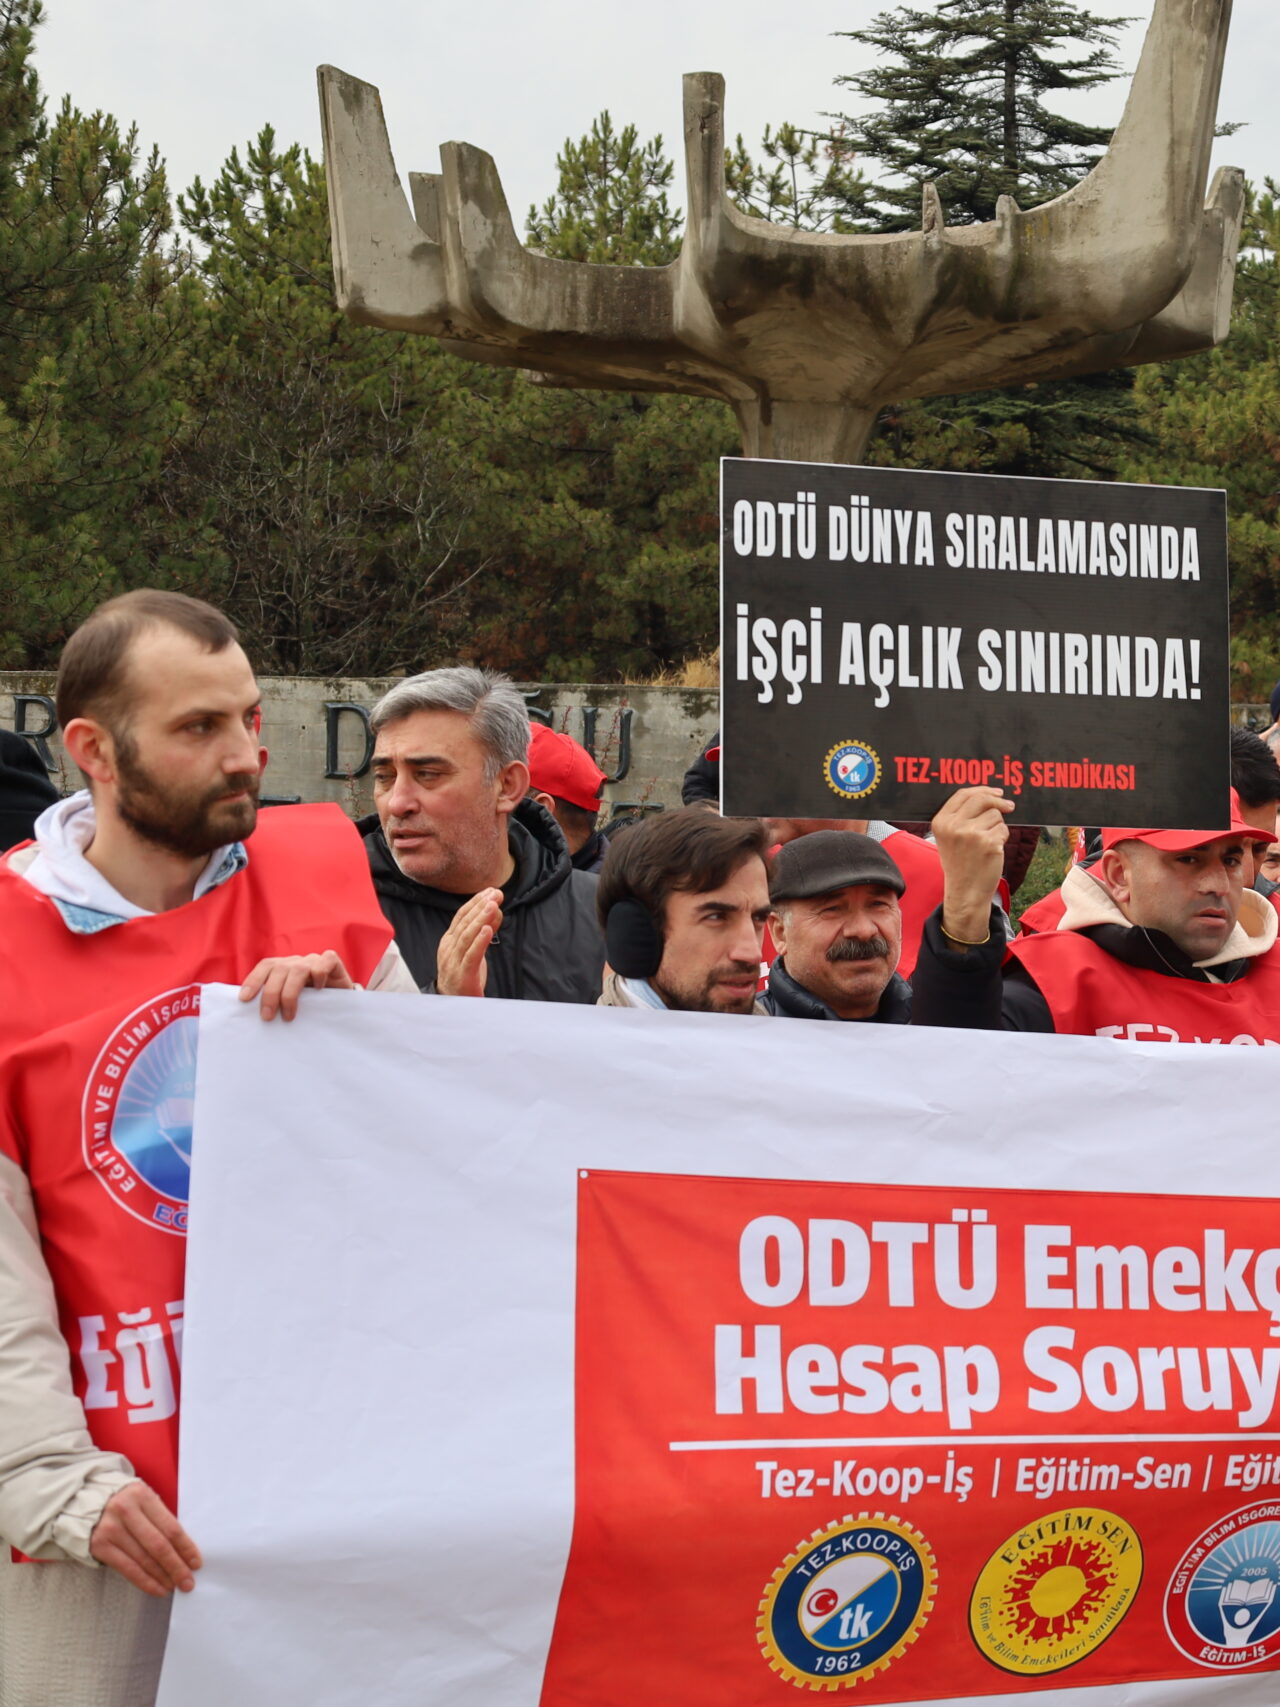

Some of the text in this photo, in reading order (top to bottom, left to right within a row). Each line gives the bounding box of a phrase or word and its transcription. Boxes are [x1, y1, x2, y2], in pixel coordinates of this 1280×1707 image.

[733, 491, 1201, 581] ODTÜ DÜNYA SIRALAMASINDA
[736, 603, 1202, 709] İŞÇİ AÇLIK SINIRINDA!
[894, 754, 1136, 795] TEZ-KOOP-İŞ SENDİKASI
[94, 1085, 114, 1114] VE
[104, 1021, 151, 1080] BİLİM
[739, 1208, 997, 1310] ODTÜ
[714, 1324, 1000, 1430] Hesap
[755, 1450, 973, 1503] Tez-Koop-İş
[1015, 1455, 1192, 1500] Eğitim-Sen
[796, 1533, 916, 1577] TEZ-KOOP-İŞ
[1096, 1519, 1133, 1556] SEN
[1240, 1567, 1268, 1578] 2005
[838, 1603, 873, 1640] tk
[814, 1652, 862, 1673] 1962
[993, 1641, 1019, 1663] Bilim
